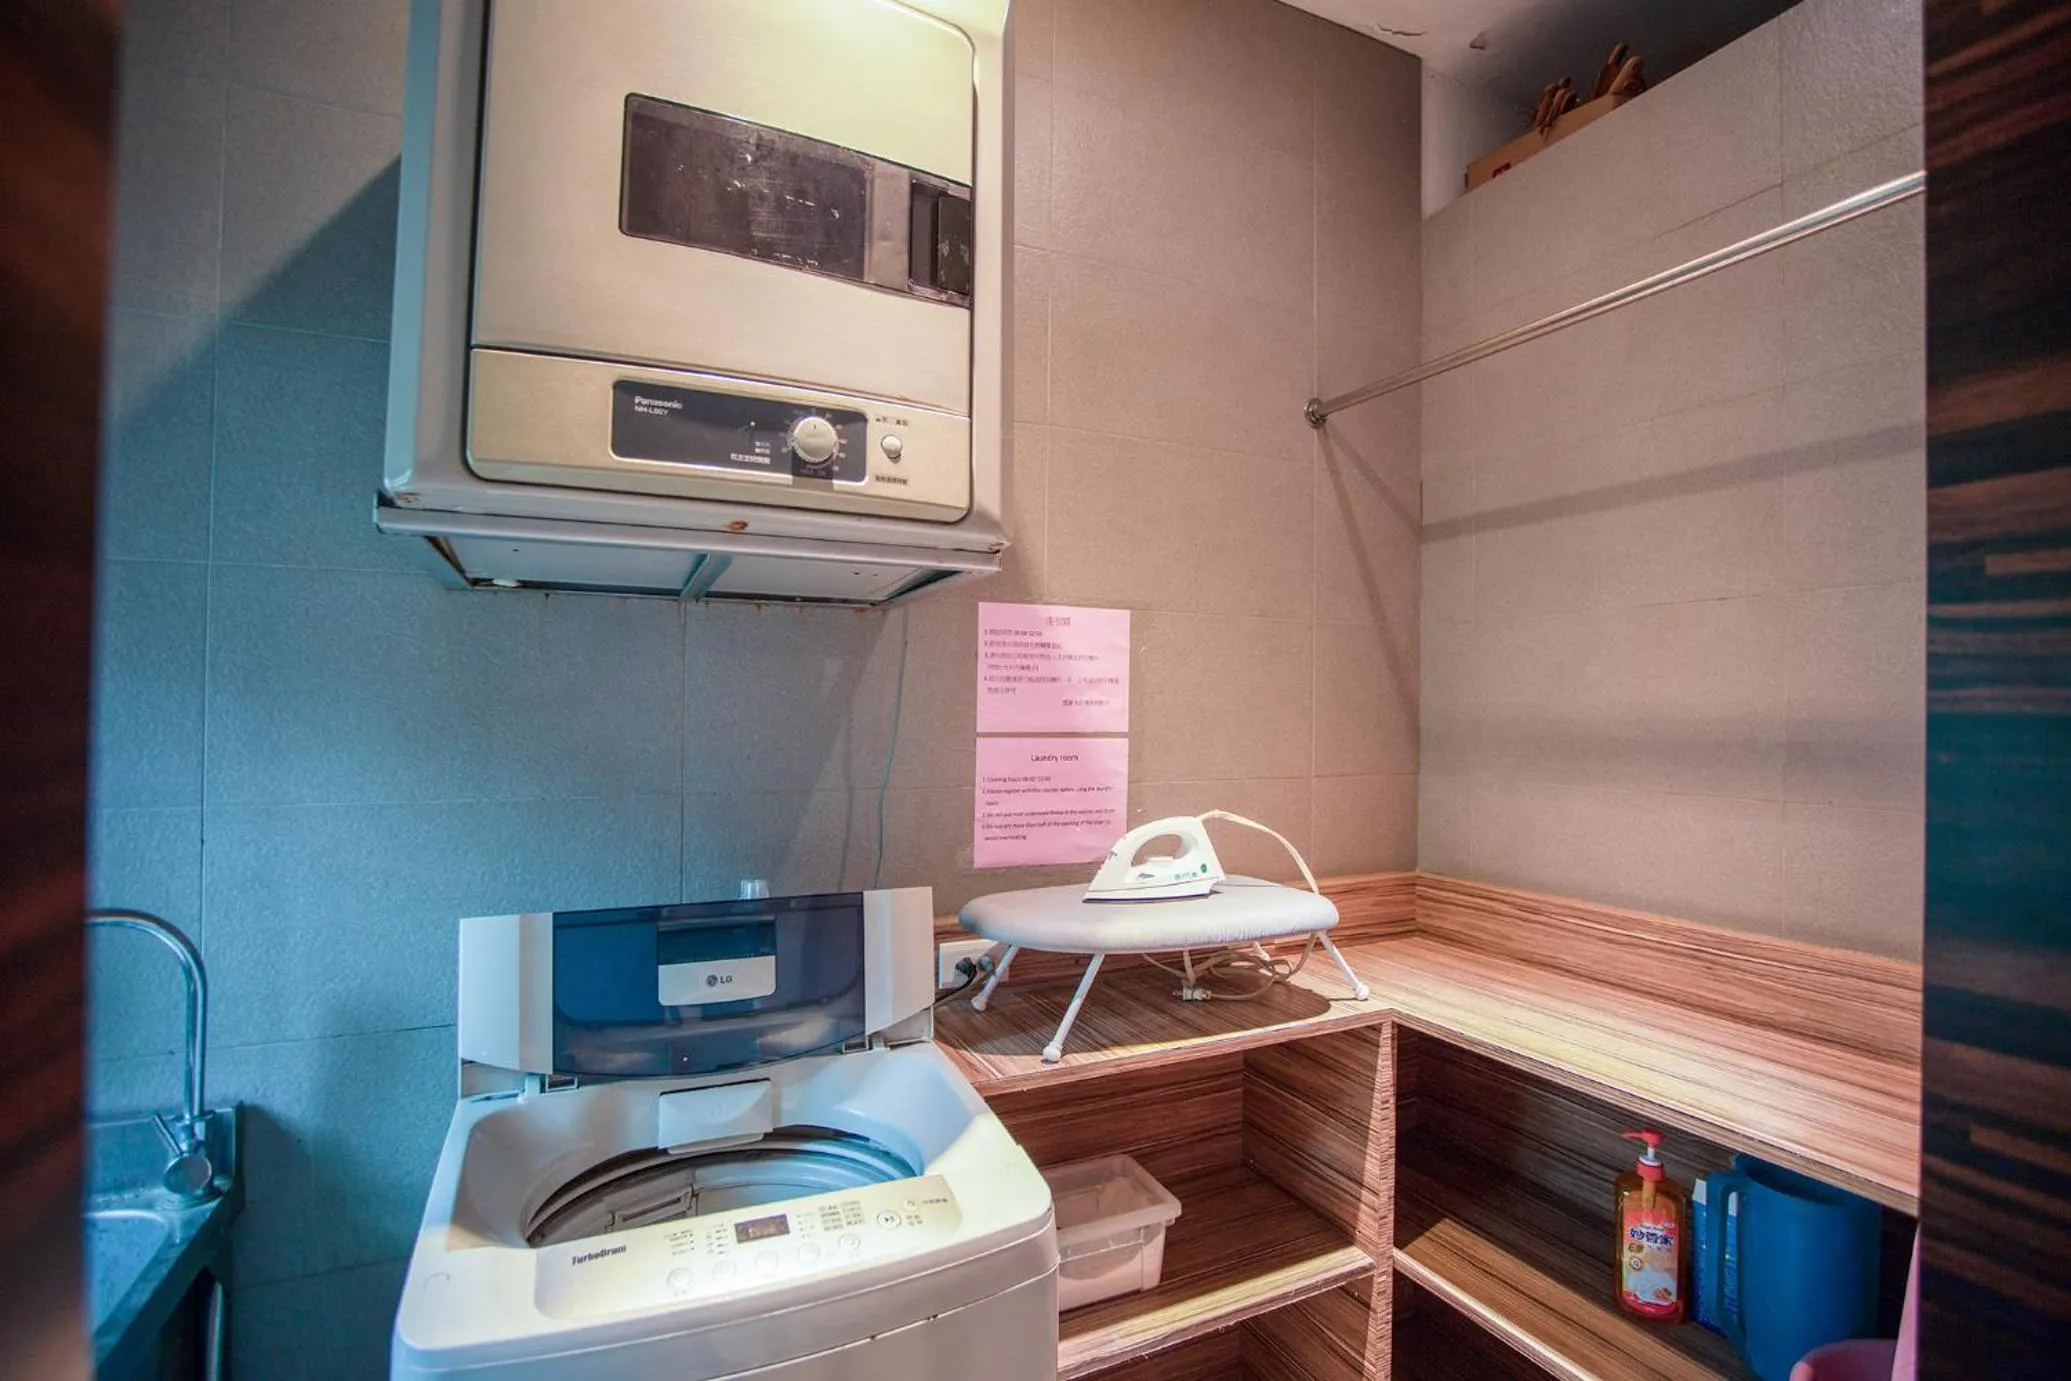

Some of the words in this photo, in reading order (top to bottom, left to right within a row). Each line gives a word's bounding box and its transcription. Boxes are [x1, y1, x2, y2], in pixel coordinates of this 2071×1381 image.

[634, 395, 683, 410] Panasonic
[720, 975, 733, 984] LG
[571, 1245, 627, 1266] TurboDrum
